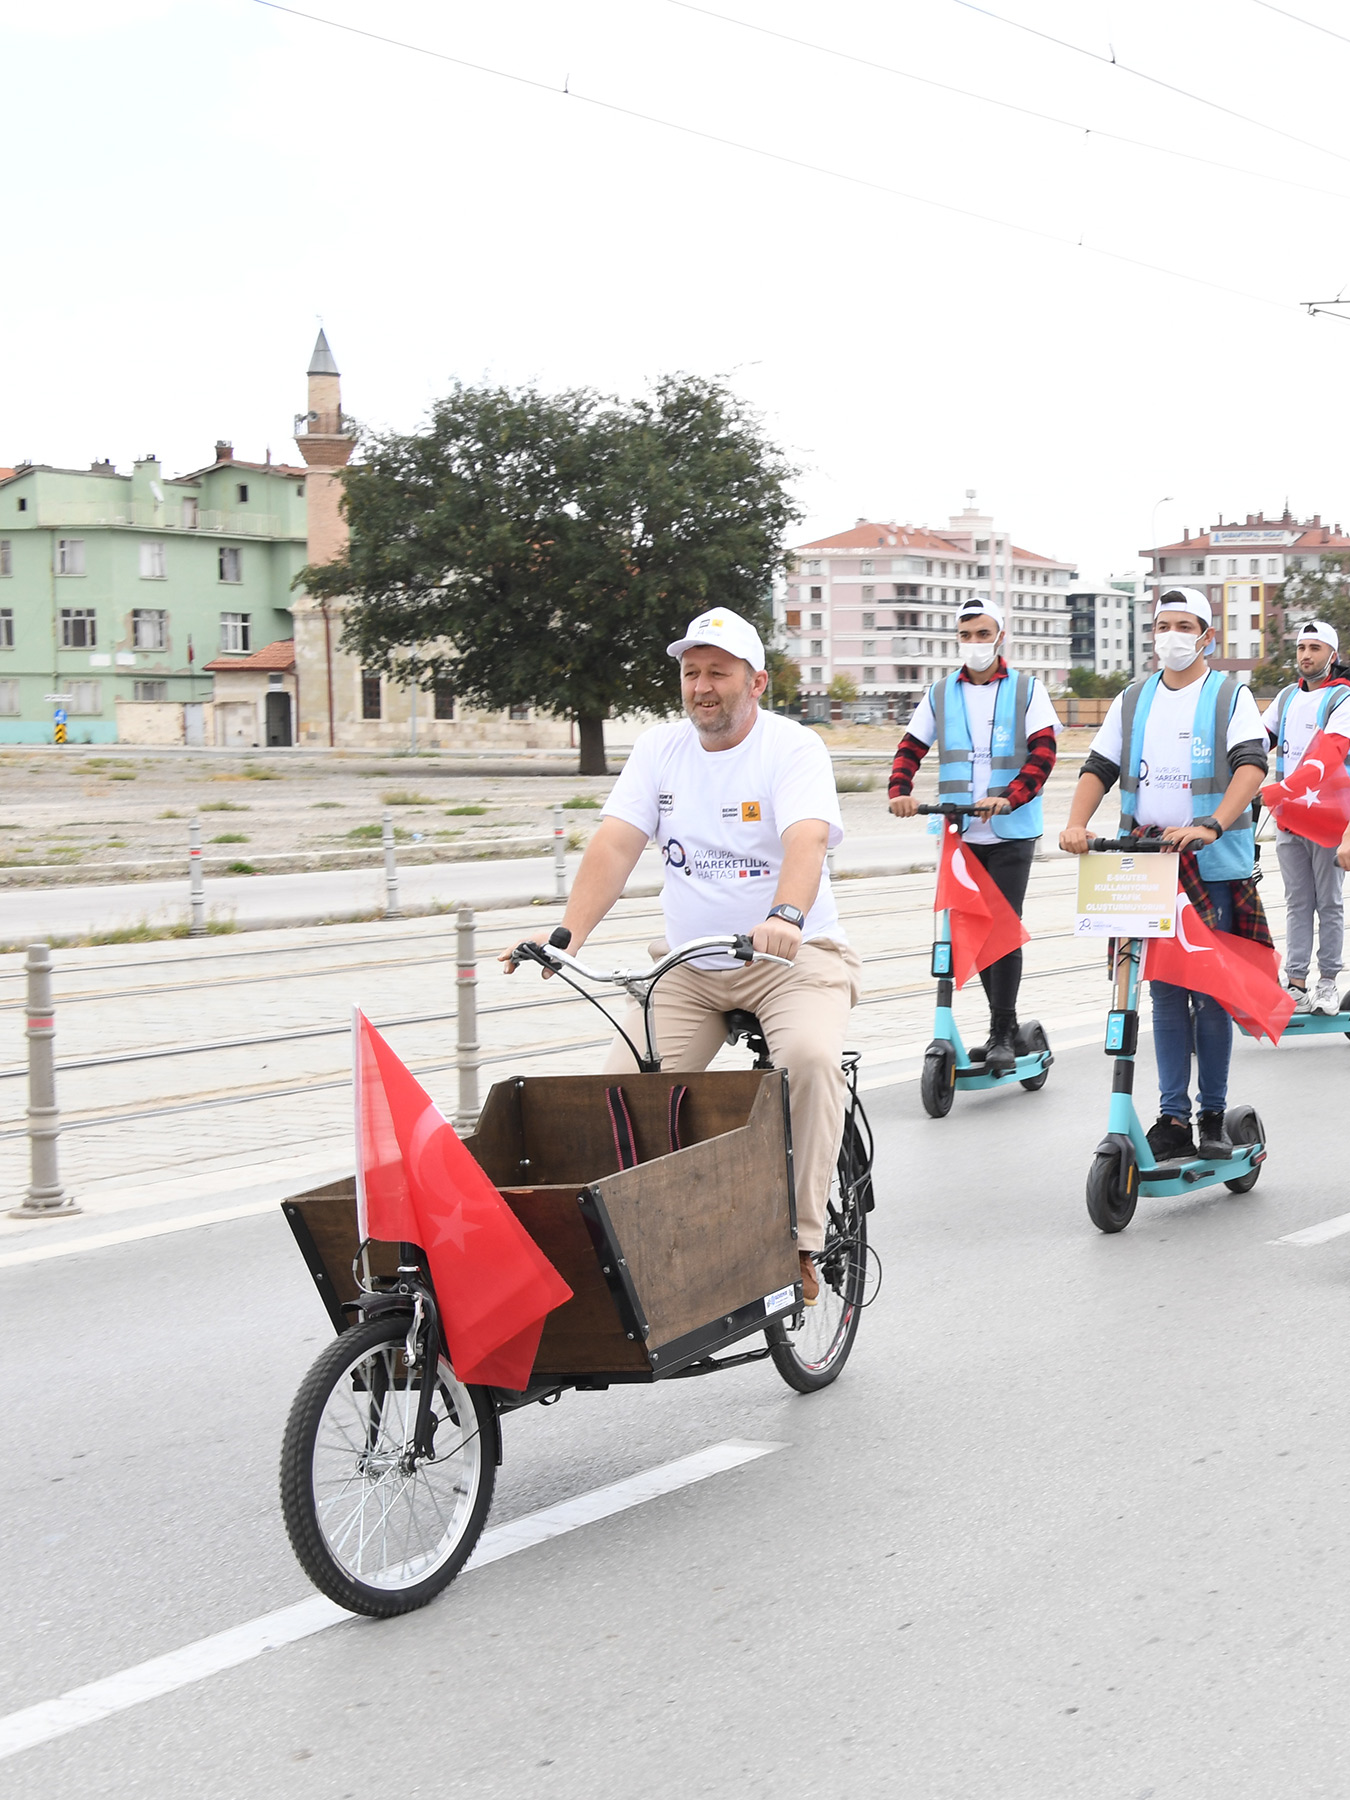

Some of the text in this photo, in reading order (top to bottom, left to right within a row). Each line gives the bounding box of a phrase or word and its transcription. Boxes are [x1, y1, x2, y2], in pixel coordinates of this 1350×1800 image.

[1192, 744, 1213, 757] bin
[693, 849, 736, 859] AVRUPA
[697, 869, 736, 879] HAFTASI
[1106, 873, 1148, 882] E-SKUTER
[1094, 883, 1160, 892] KULLANIYORUM
[1111, 892, 1142, 901] TRAFİK
